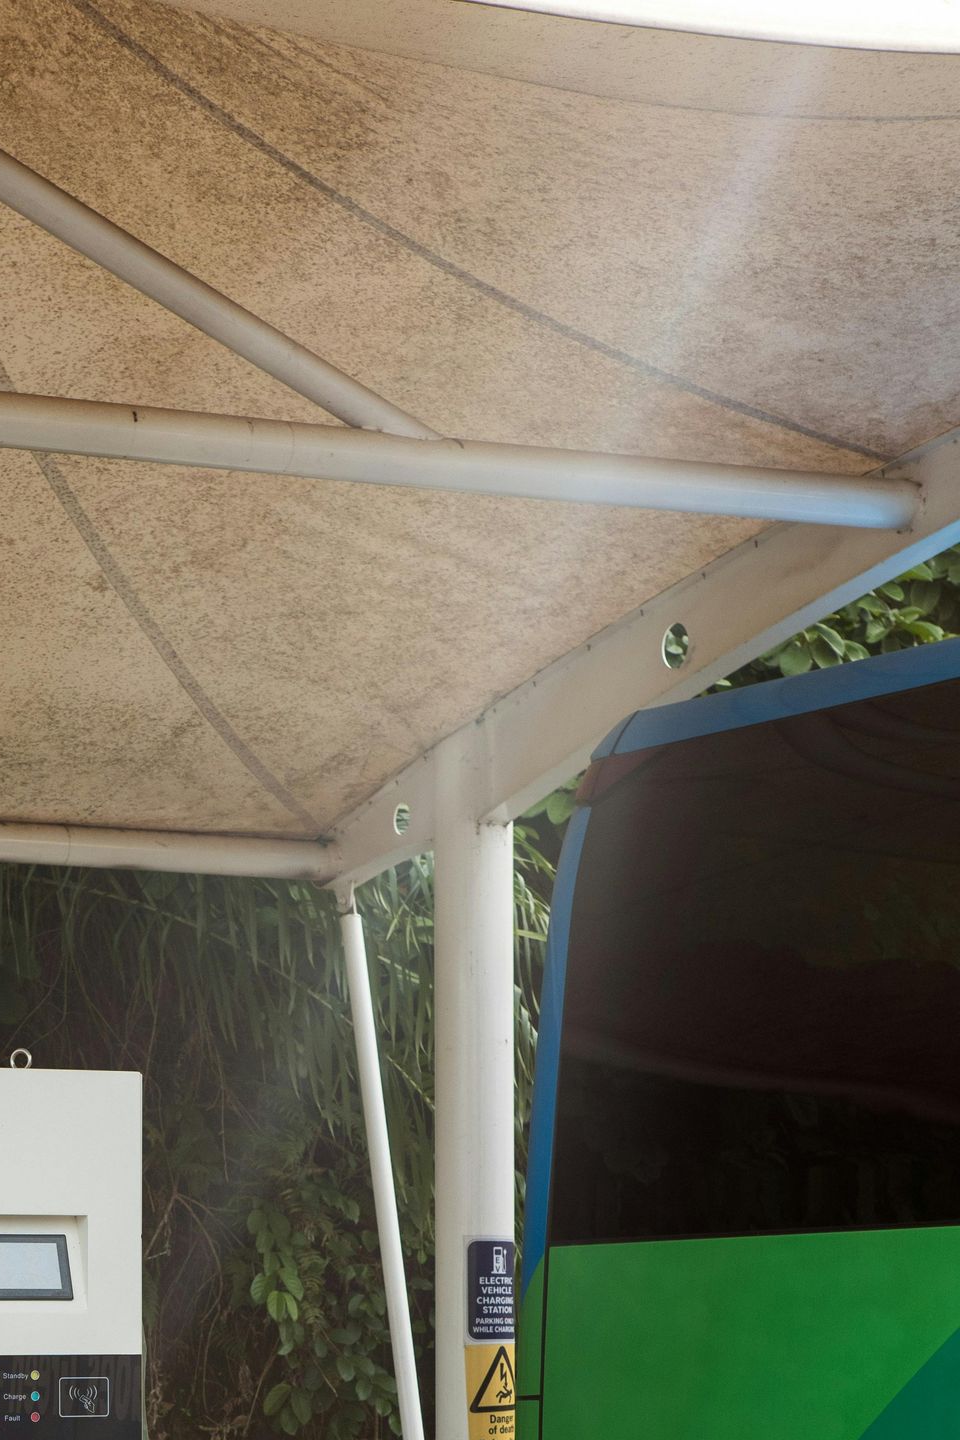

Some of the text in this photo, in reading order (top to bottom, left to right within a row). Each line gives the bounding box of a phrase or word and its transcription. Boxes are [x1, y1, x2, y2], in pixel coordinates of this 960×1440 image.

[479, 1276, 513, 1285] ELECTRIC
[481, 1286, 513, 1295] VEHICLE
[482, 1306, 513, 1314] STATION
[475, 1317, 504, 1325] PARKING
[2, 1372, 29, 1380] Standby
[3, 1393, 27, 1401] Charge
[488, 1425, 497, 1435] of
